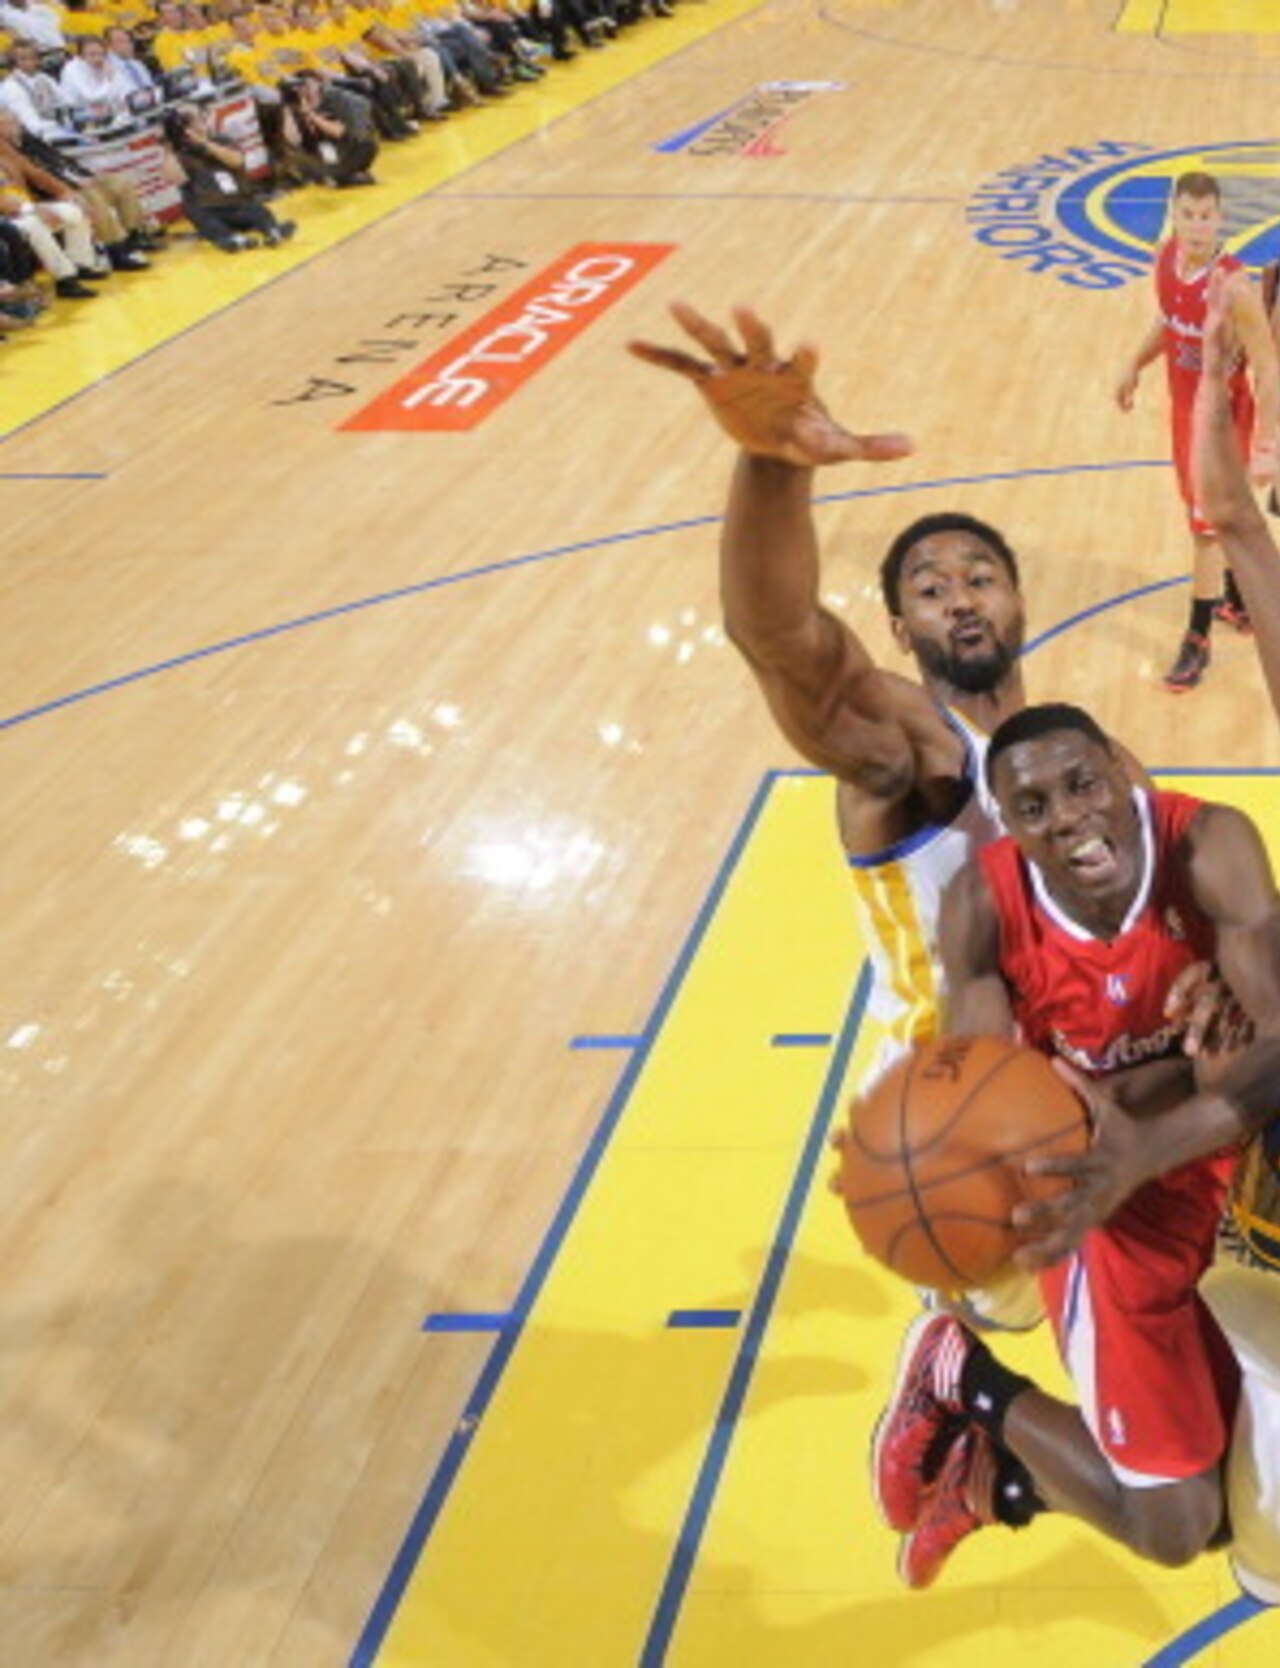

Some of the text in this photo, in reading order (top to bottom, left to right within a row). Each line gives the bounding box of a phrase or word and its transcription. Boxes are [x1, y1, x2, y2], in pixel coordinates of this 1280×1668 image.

[964, 140, 1155, 290] WARRIORS
[268, 253, 528, 407] ARENA
[402, 254, 635, 409] ORACLE
